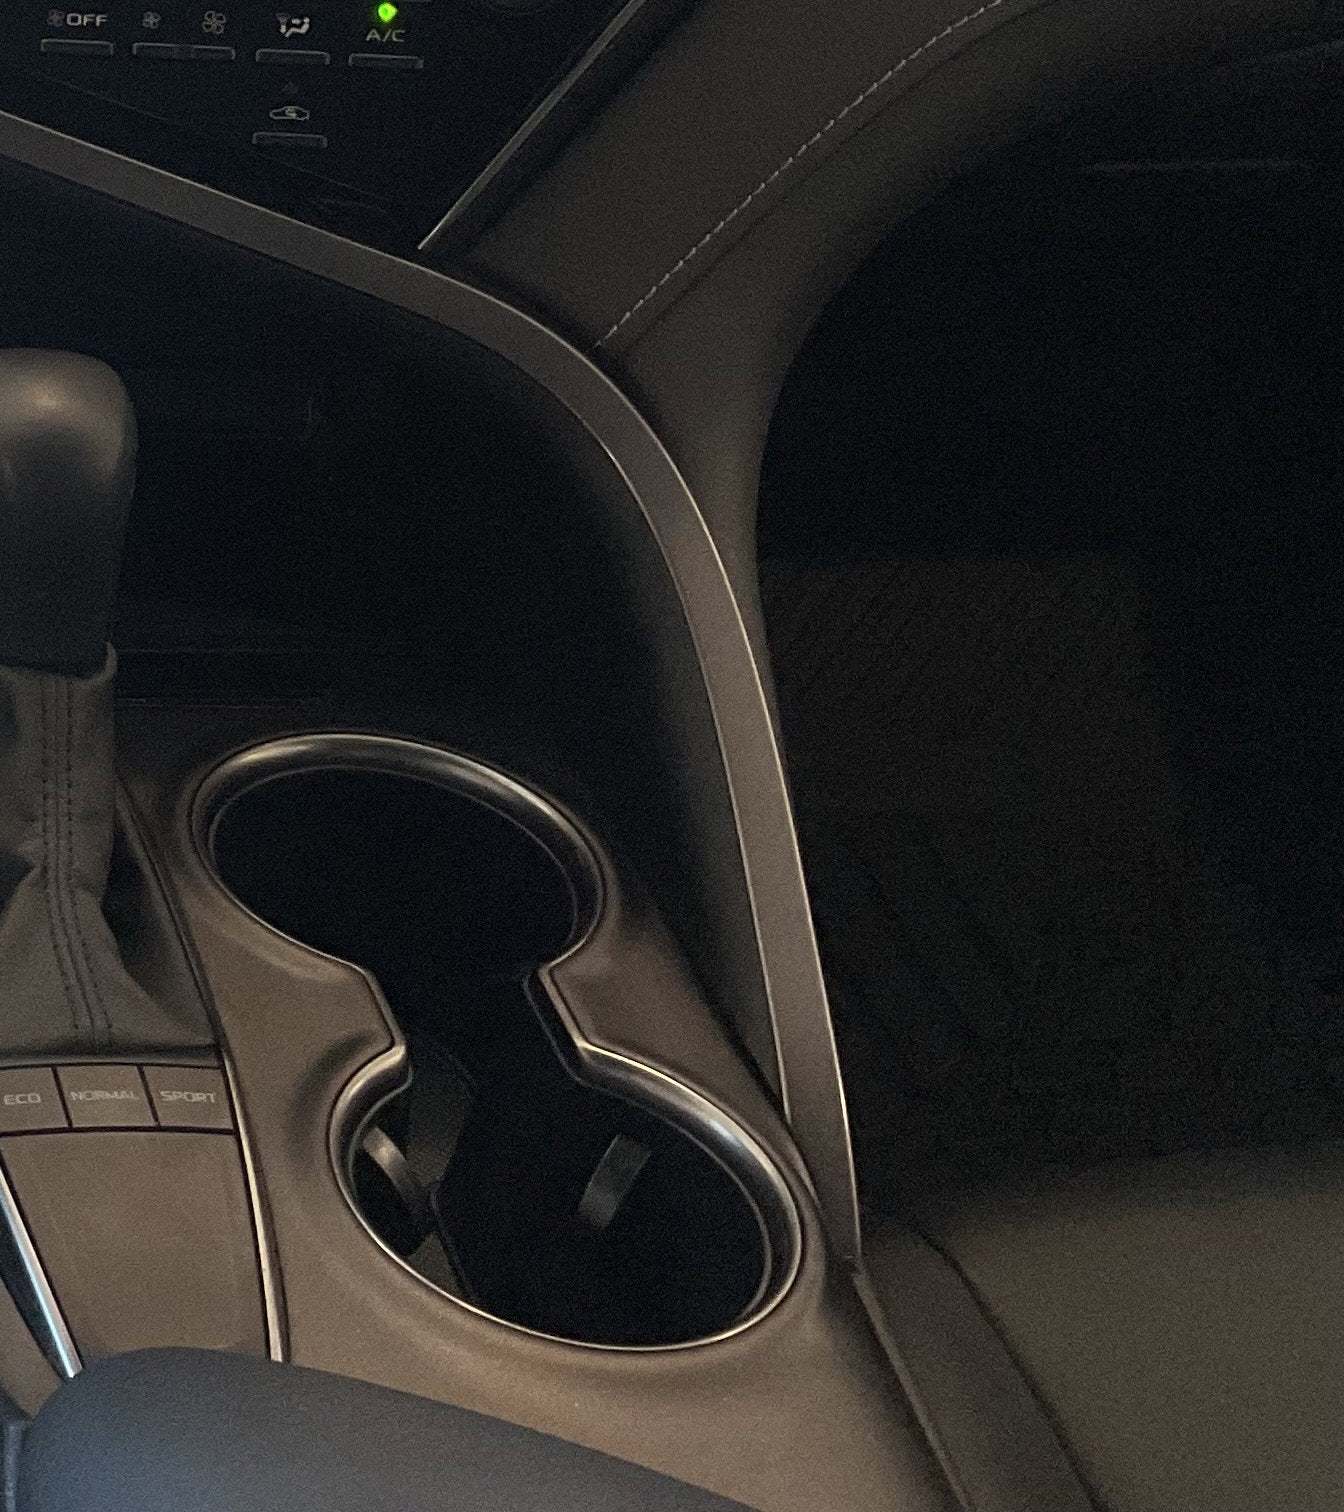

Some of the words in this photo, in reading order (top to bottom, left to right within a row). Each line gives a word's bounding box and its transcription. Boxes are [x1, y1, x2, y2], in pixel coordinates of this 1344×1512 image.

[66, 13, 109, 28] OFF
[365, 28, 406, 43] A/C
[3, 1092, 42, 1106] ECO
[71, 1090, 139, 1102] NORMAL
[159, 1090, 217, 1104] SPORT
